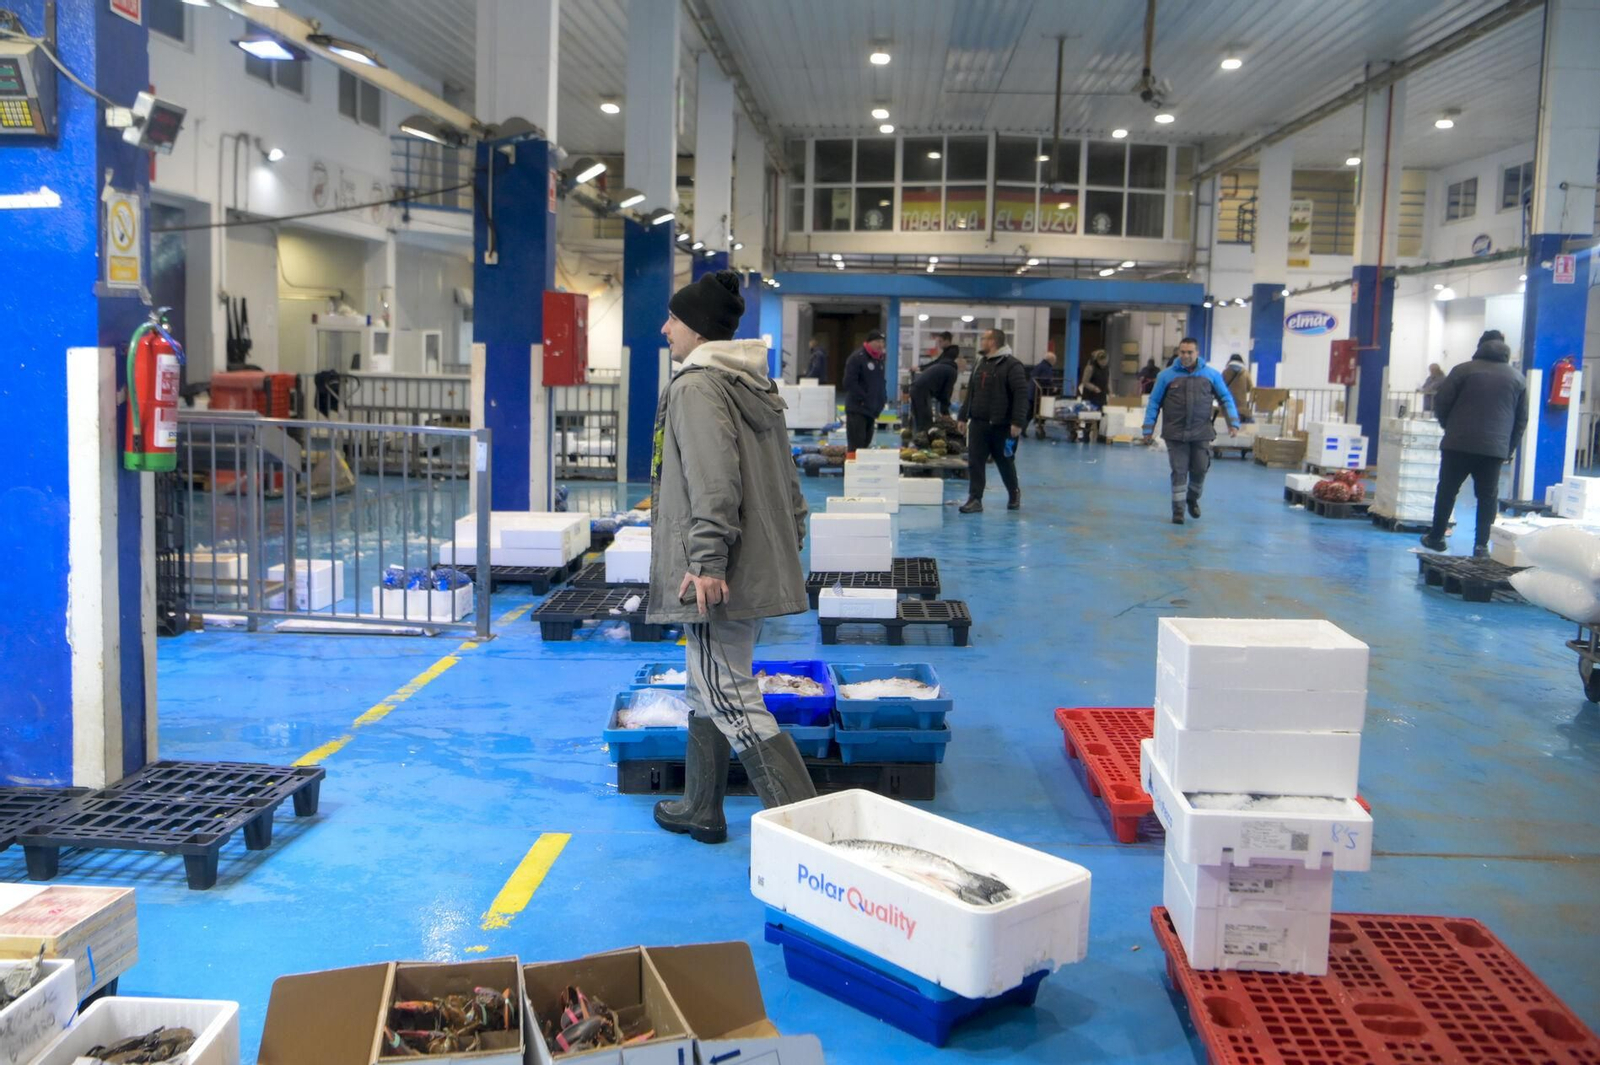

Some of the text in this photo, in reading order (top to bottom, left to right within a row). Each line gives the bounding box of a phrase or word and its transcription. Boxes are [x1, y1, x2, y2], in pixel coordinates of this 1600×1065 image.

[995, 210, 1015, 230] EL
[1021, 210, 1076, 232] BUZO
[1288, 314, 1331, 329] elmar
